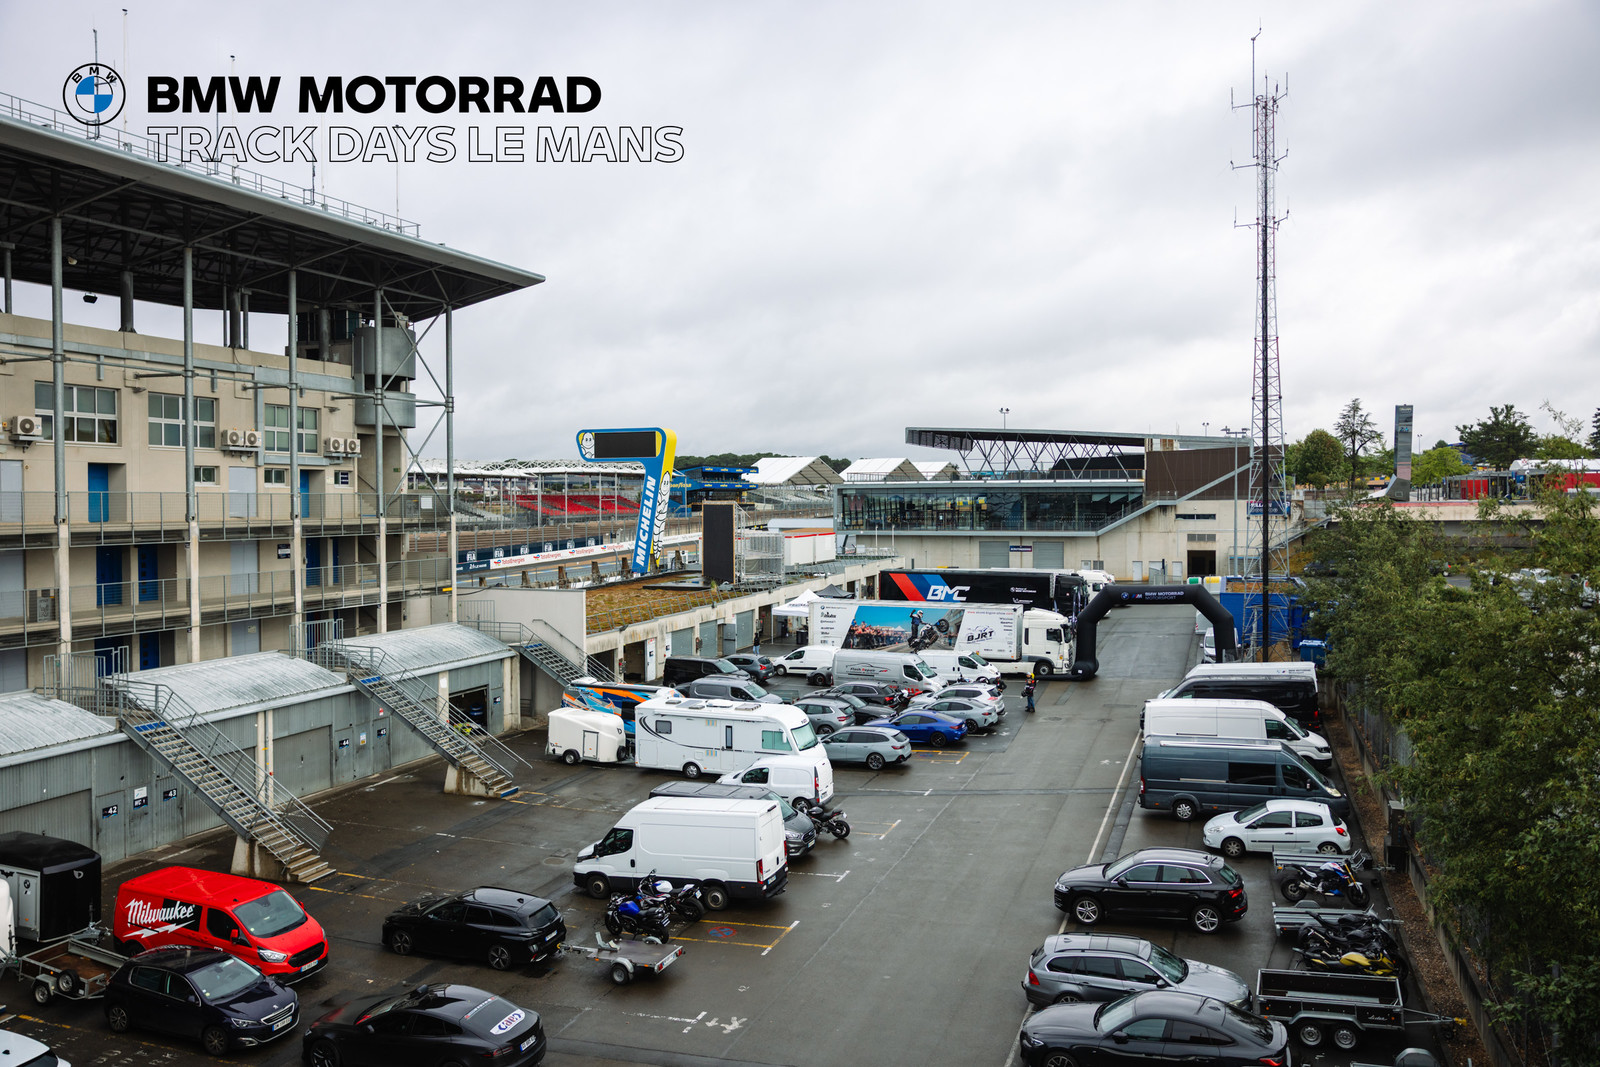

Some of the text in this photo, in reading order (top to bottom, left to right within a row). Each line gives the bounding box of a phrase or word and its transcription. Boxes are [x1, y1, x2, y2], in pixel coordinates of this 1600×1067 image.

[636, 475, 656, 567] MICHELIN
[927, 585, 971, 601] BMC
[967, 630, 995, 642] BJRT
[168, 789, 177, 797] 43
[107, 805, 117, 815] 42
[125, 898, 195, 928] Milwaukee
